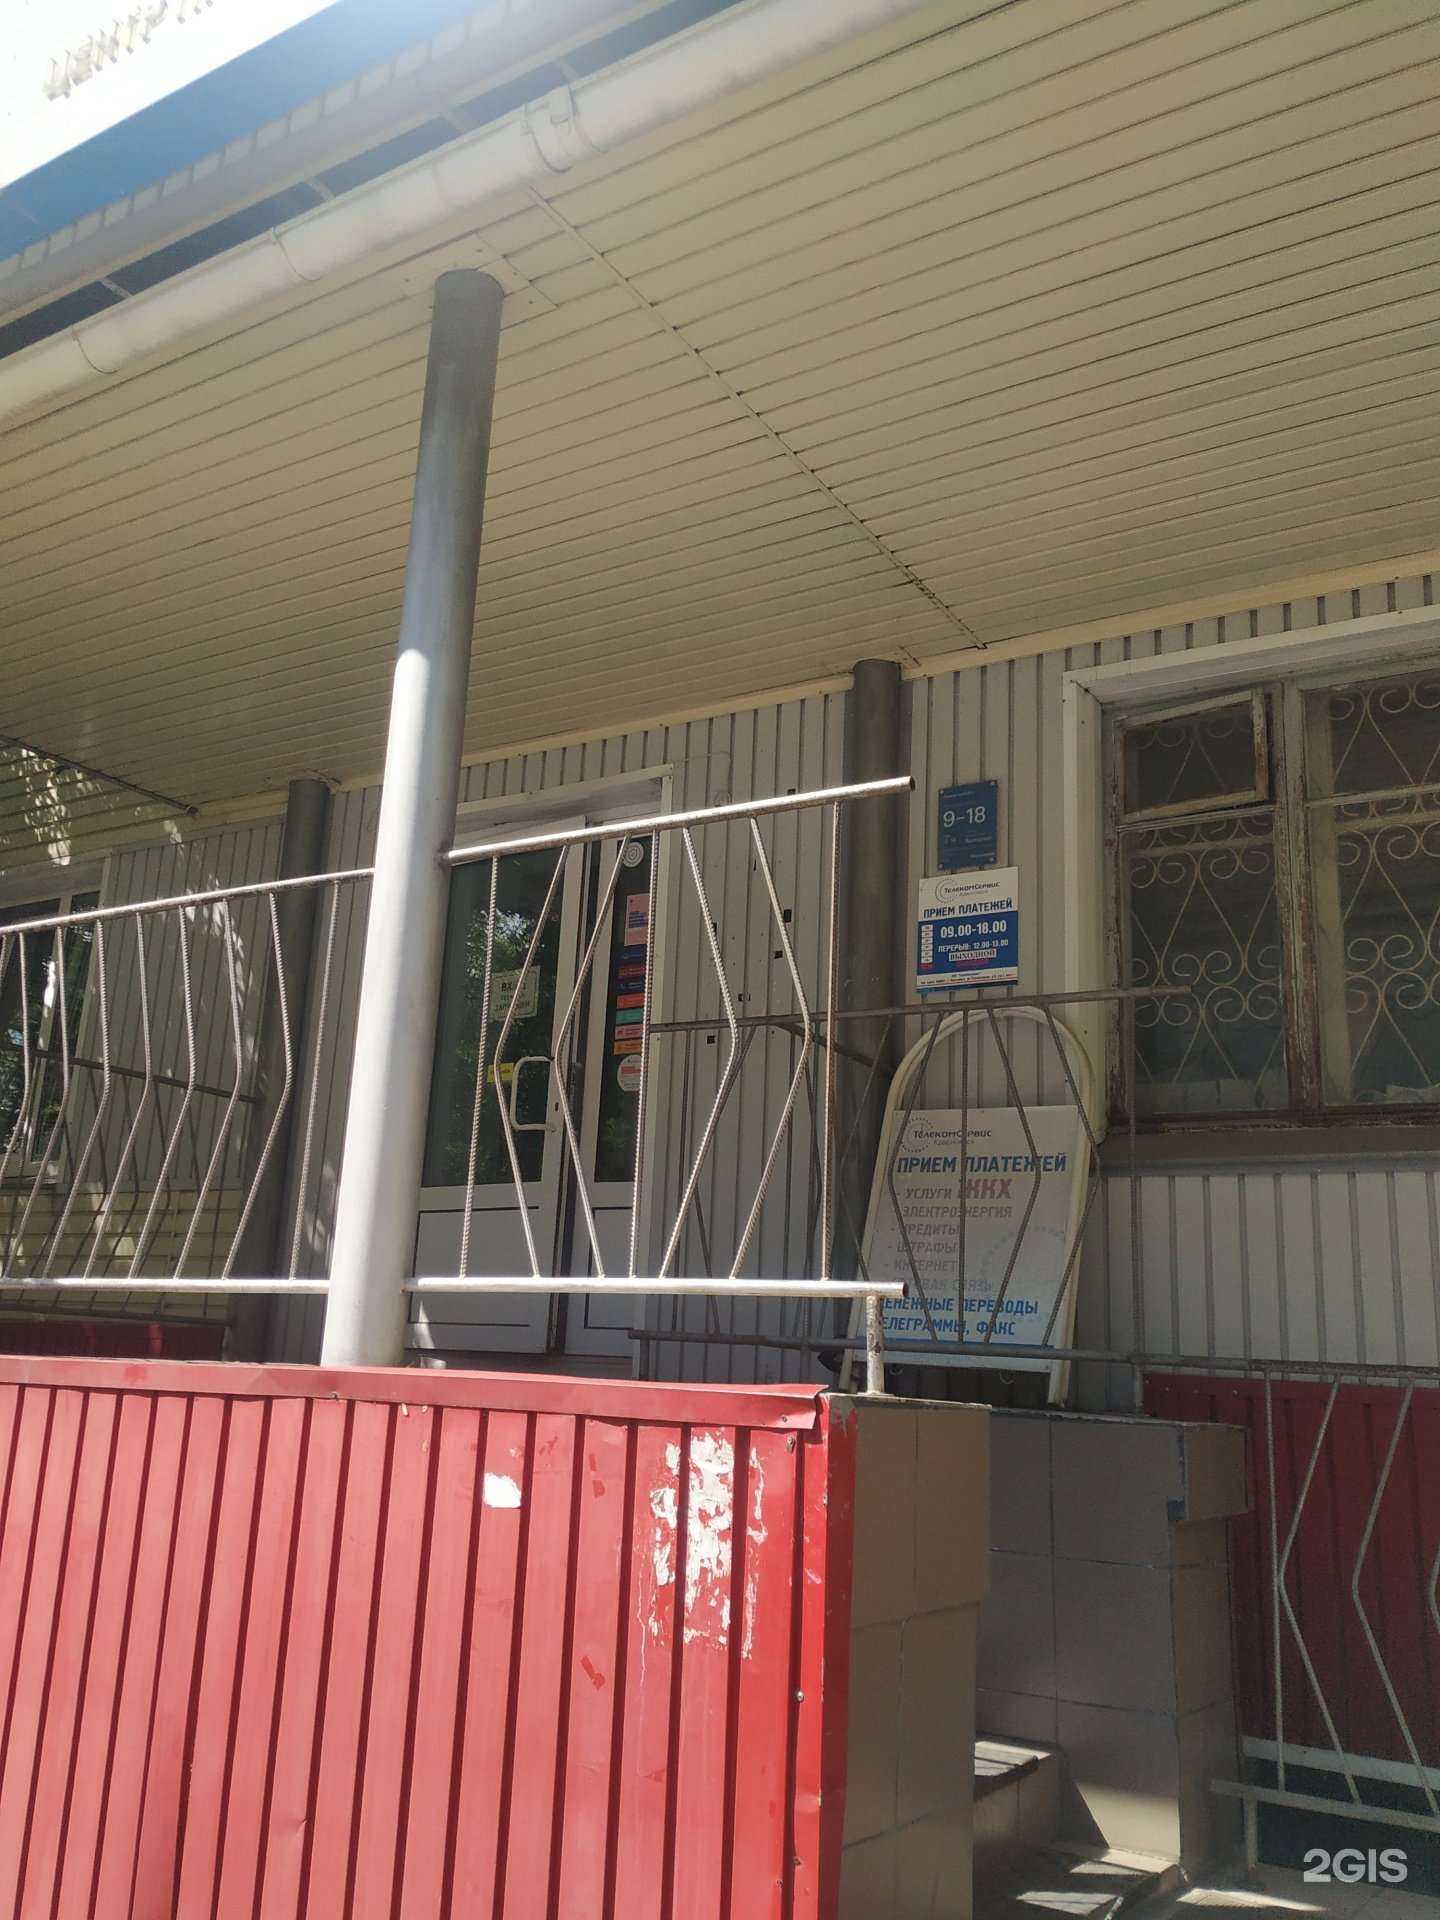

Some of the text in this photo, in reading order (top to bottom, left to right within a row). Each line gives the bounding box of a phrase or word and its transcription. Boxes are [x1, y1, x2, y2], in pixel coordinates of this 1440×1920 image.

[943, 806, 986, 828] 9-18
[923, 895, 1013, 919] ПРИЕМ ПЛАТЕЖЕЙ
[940, 919, 1007, 938] 09.00-18.00
[896, 1156, 957, 1173] ПРИЕМ
[904, 1187, 953, 1200] УСЛУГИ
